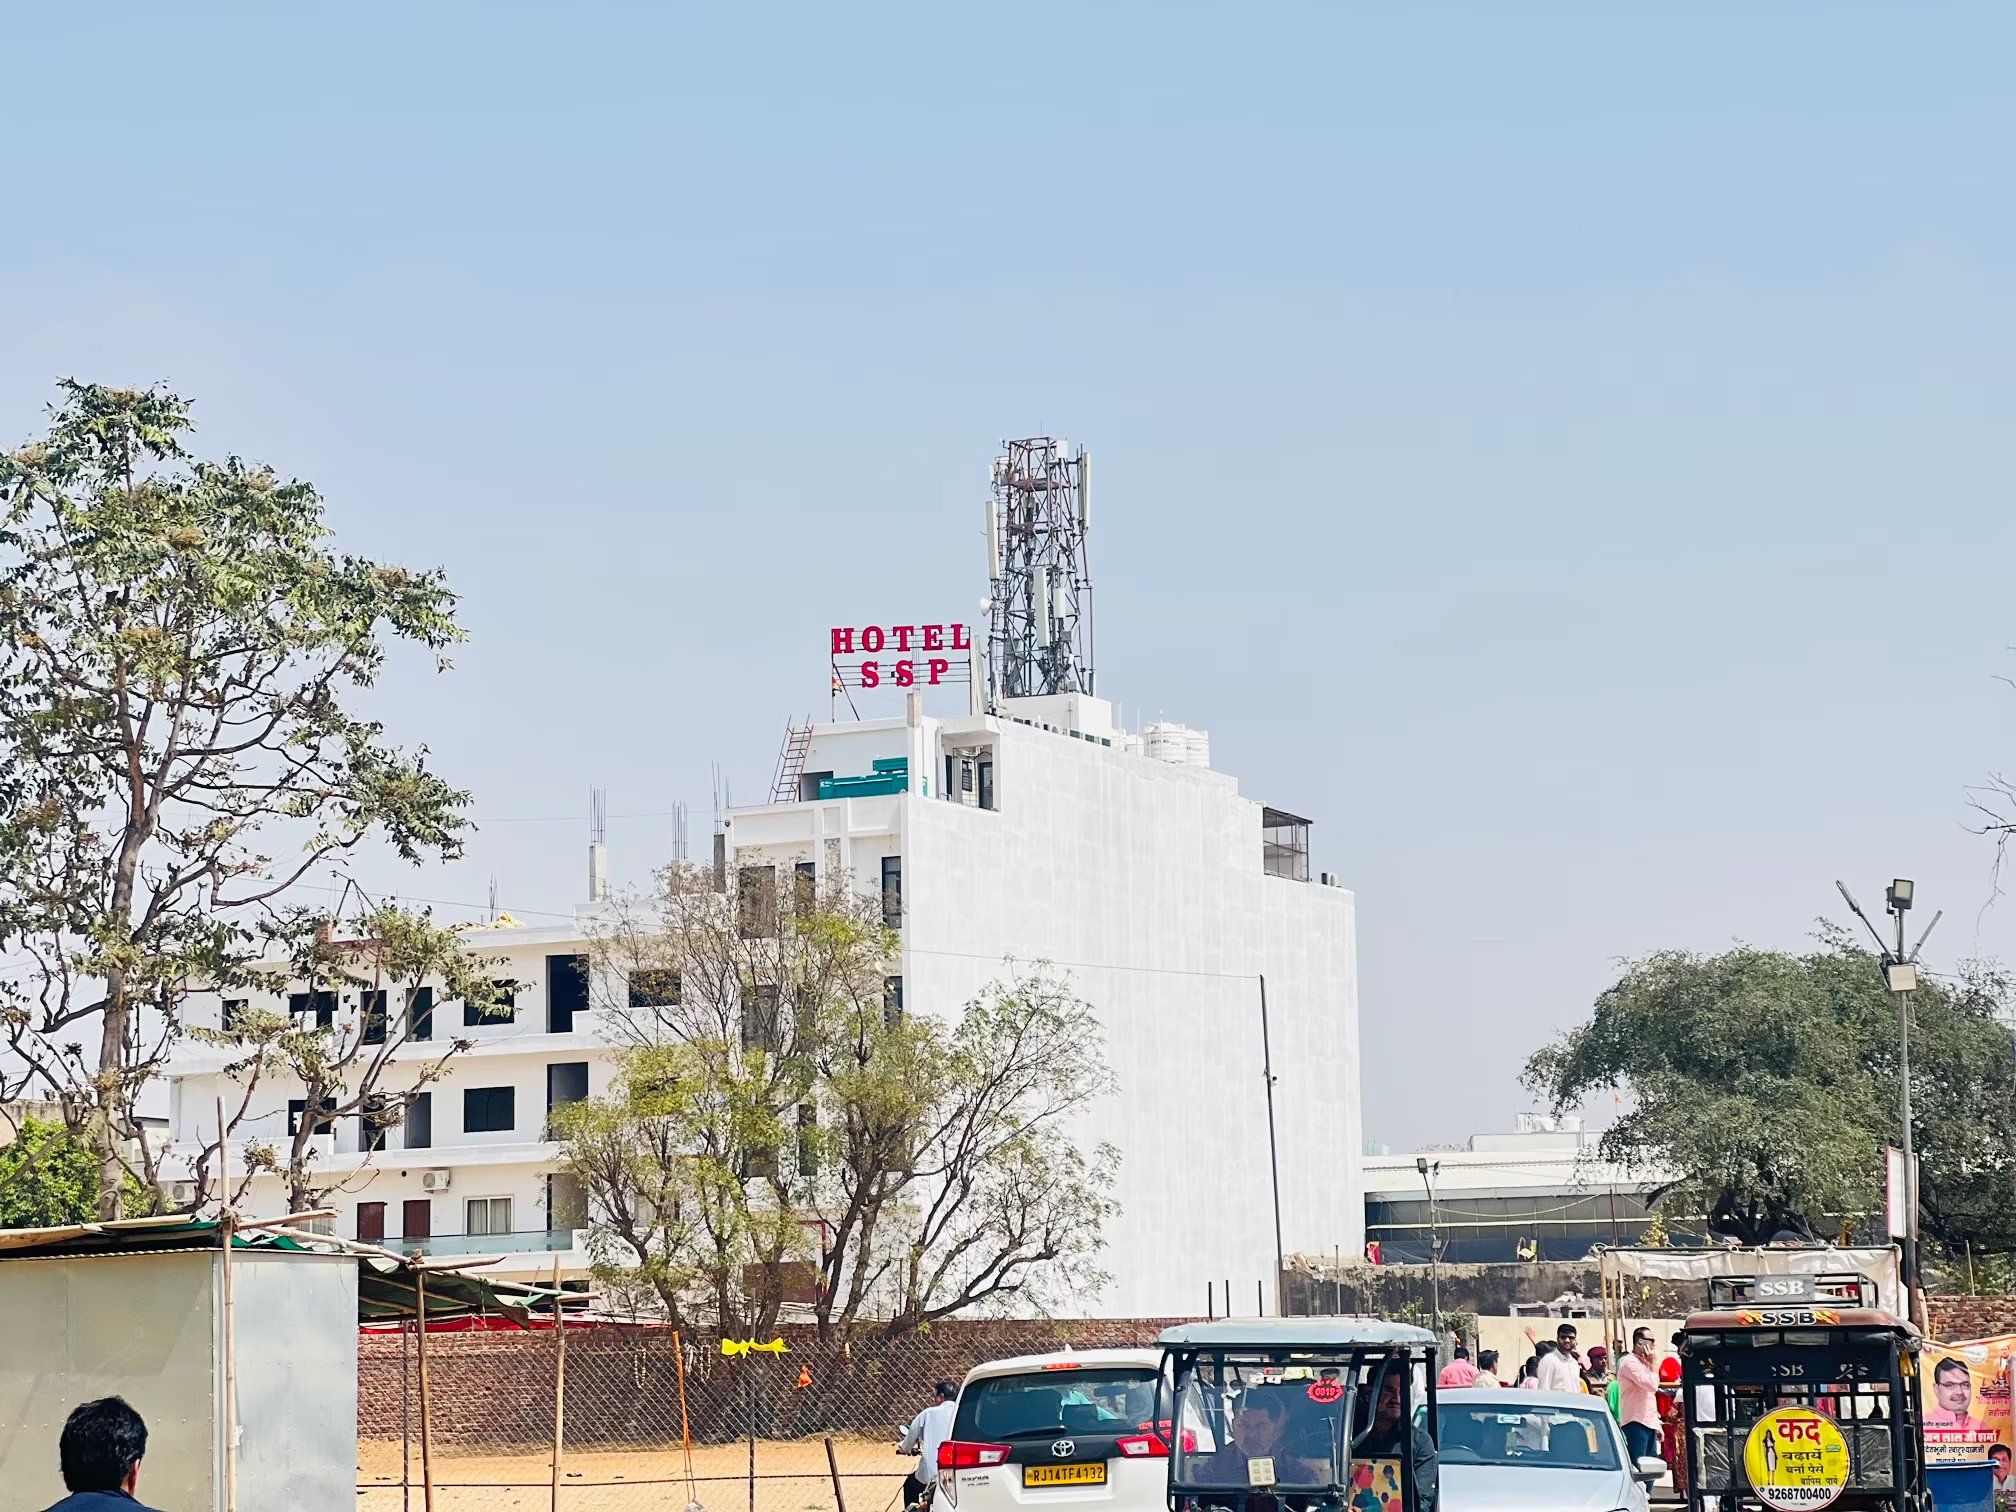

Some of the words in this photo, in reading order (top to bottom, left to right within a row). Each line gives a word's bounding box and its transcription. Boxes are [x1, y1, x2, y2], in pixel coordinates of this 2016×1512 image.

[831, 624, 970, 654] HOTEL
[861, 659, 949, 688] SSP
[1760, 1281, 1805, 1296] SSB
[1761, 1311, 1817, 1325] SSB
[1315, 1387, 1335, 1396] 0019
[1776, 1419, 1822, 1445] कद
[1941, 1433, 1962, 1442] लाल
[1965, 1430, 1976, 1442] जी
[1977, 1430, 1997, 1442] शर्मा
[1033, 1466, 1103, 1482] RJ14TF4132
[1768, 1487, 1831, 1500] 9268700400
